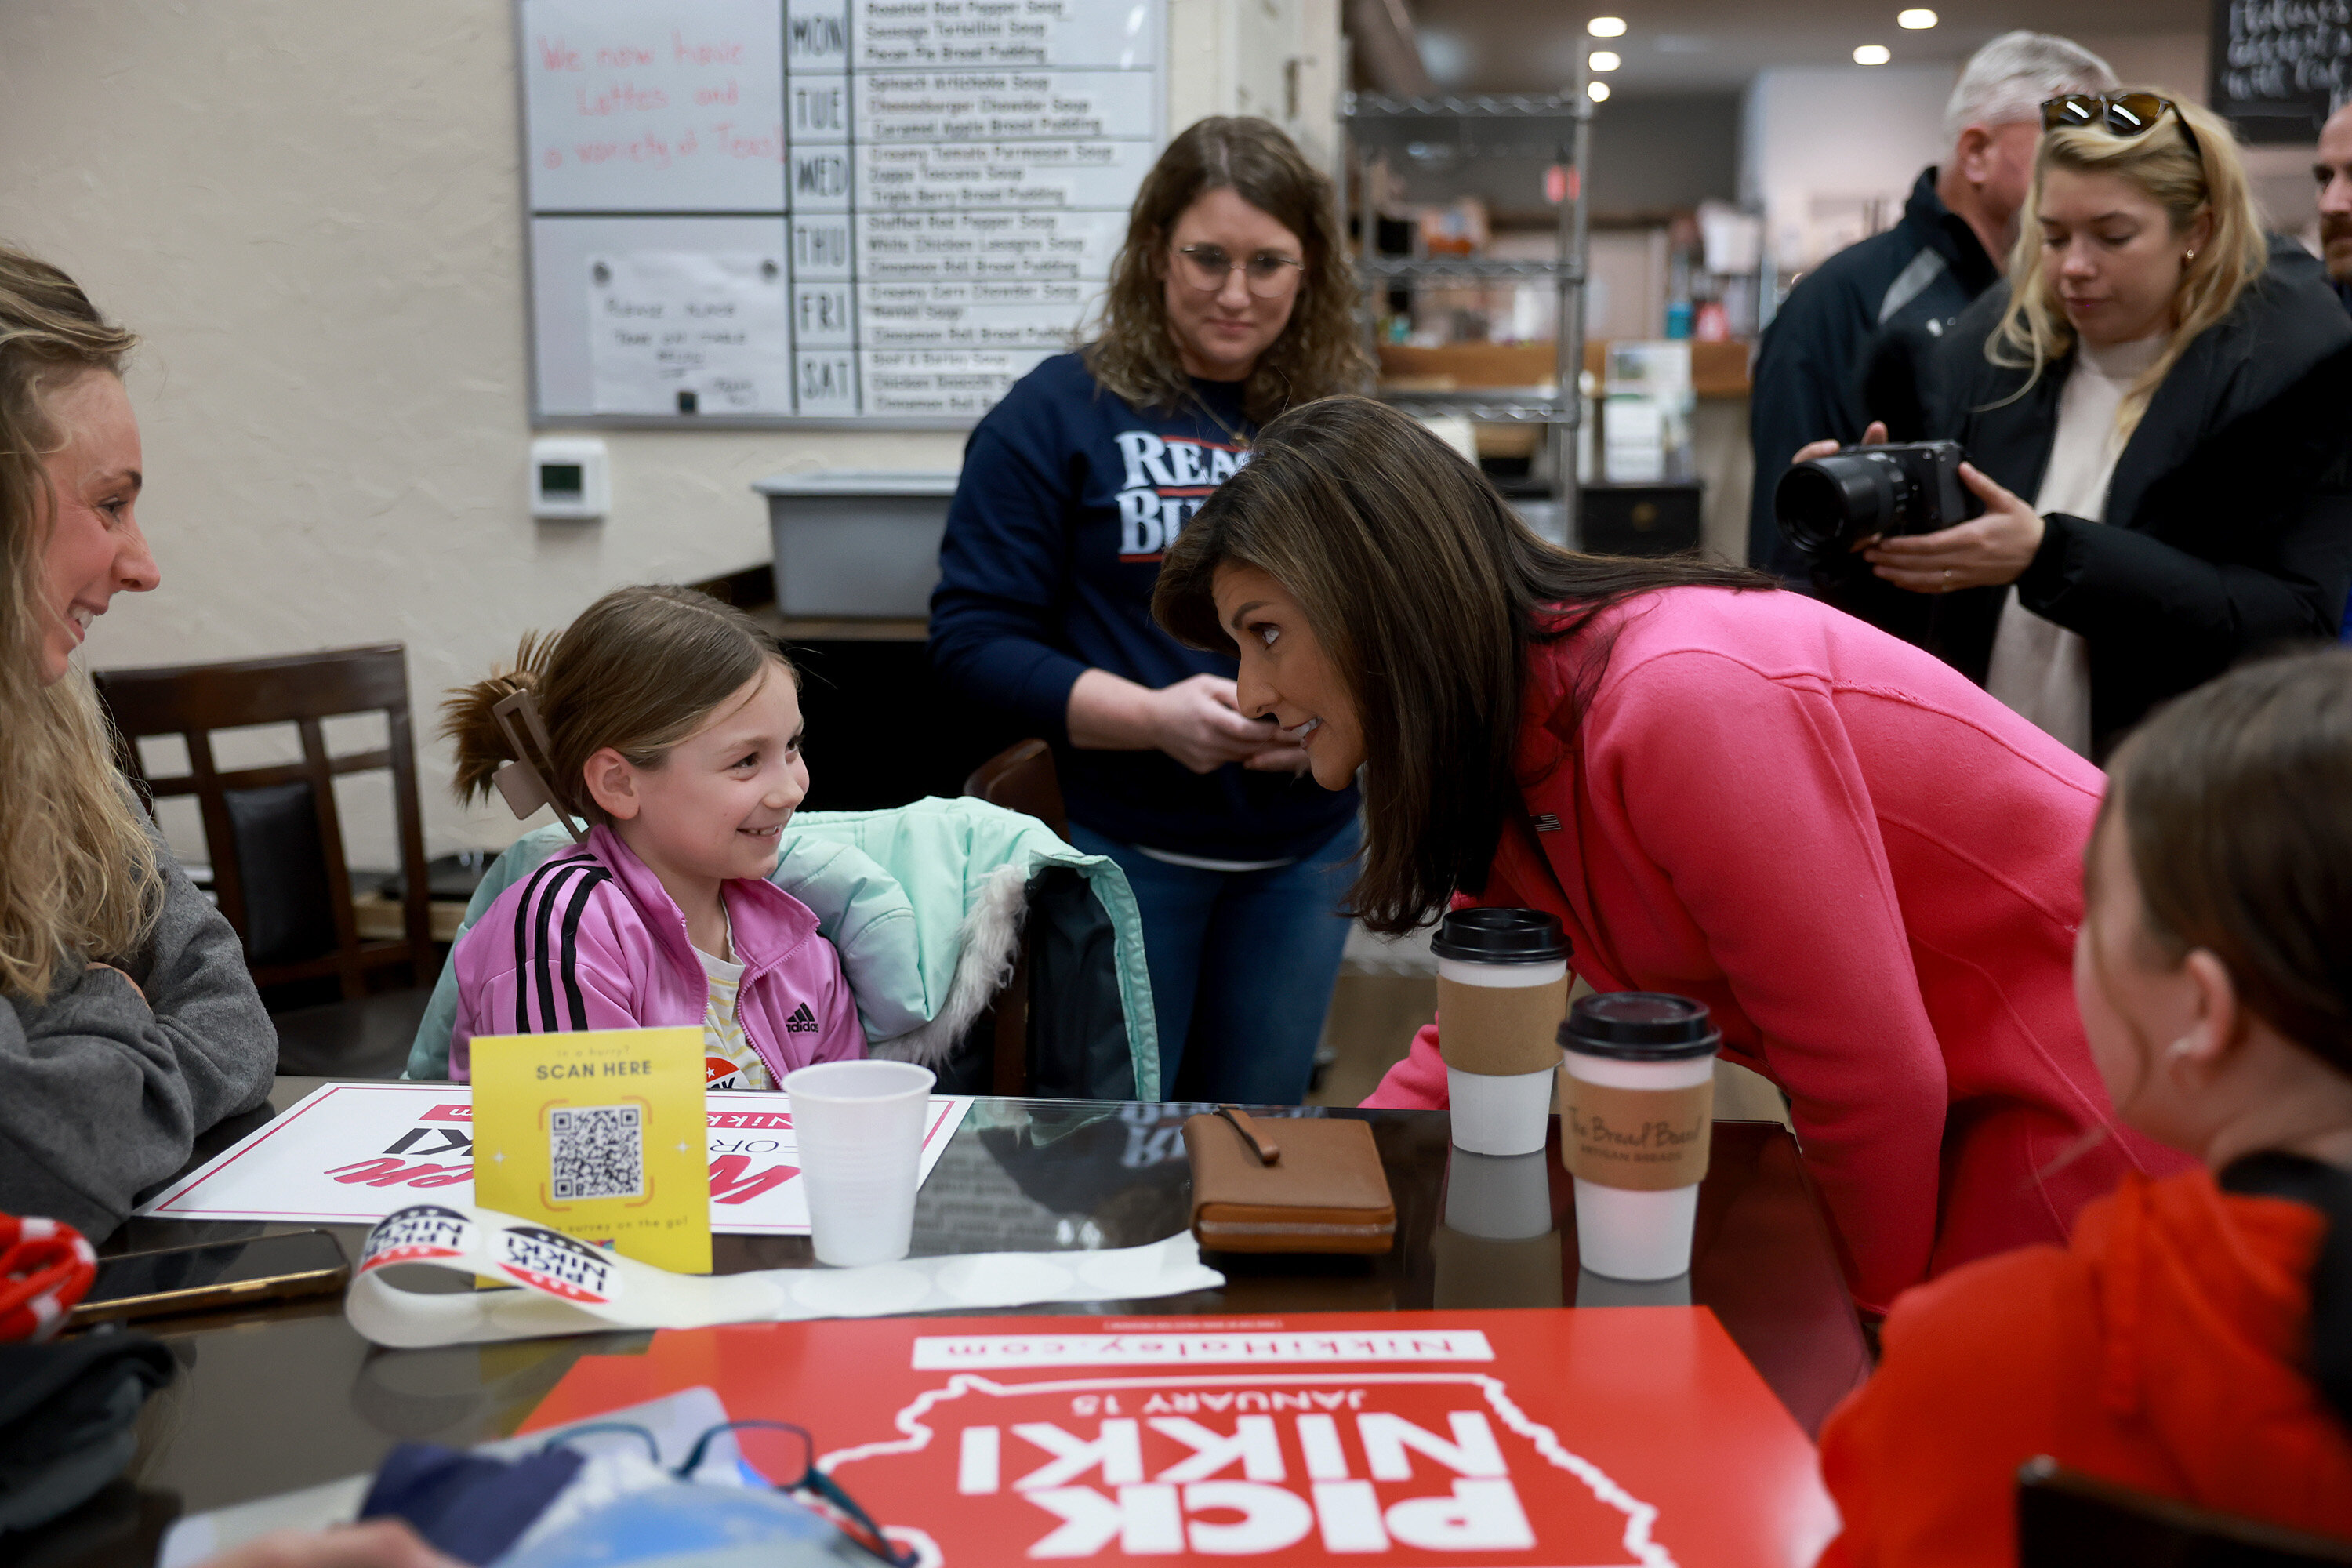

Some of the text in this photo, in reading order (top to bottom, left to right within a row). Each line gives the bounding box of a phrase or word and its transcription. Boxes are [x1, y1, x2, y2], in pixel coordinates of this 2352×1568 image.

[1027, 1, 1062, 16] Soup
[792, 18, 844, 56] MON
[1010, 22, 1045, 38] Soup
[537, 27, 743, 72] We now have
[942, 46, 982, 59] Bread
[989, 45, 1045, 62] Pudding
[1013, 76, 1048, 92] Soup
[575, 78, 740, 116] Lattes and
[1052, 99, 1088, 114] Soup
[797, 88, 841, 130] TUE
[992, 119, 1033, 132] Bread
[1041, 118, 1101, 135] Pudding
[543, 147, 563, 170] a
[575, 129, 673, 170] variety
[676, 127, 699, 156] of
[1076, 145, 1112, 161] Soup
[797, 158, 847, 197] WED
[987, 167, 1024, 182] Soup
[962, 189, 1001, 201] Bread
[1009, 188, 1064, 205] Pudding
[1021, 216, 1054, 230] Soup
[797, 227, 845, 267] THU
[1048, 238, 1083, 252] Soup
[976, 261, 1015, 274] Bread
[1023, 260, 1079, 277] Pudding
[1044, 285, 1079, 301] Soup
[800, 295, 846, 332] FRI
[982, 328, 1019, 340] Bread
[973, 353, 1007, 368] Soup
[803, 361, 848, 399] SAT
[589, 1044, 630, 1059] hurry?
[536, 1060, 652, 1080] SCAN HERE
[1592, 1116, 1651, 1148] Bread
[370, 1221, 463, 1240] NIKK
[568, 1223, 611, 1233] survey
[638, 1218, 659, 1228] the
[506, 1237, 605, 1279] NIKKI
[508, 1250, 584, 1284] PICK
[947, 1336, 1453, 1357] NikkiHaley.com
[1069, 1389, 1367, 1417] JANUARY 15
[957, 1410, 1509, 1495] NIKKI
[1020, 1479, 1537, 1559] PICK
